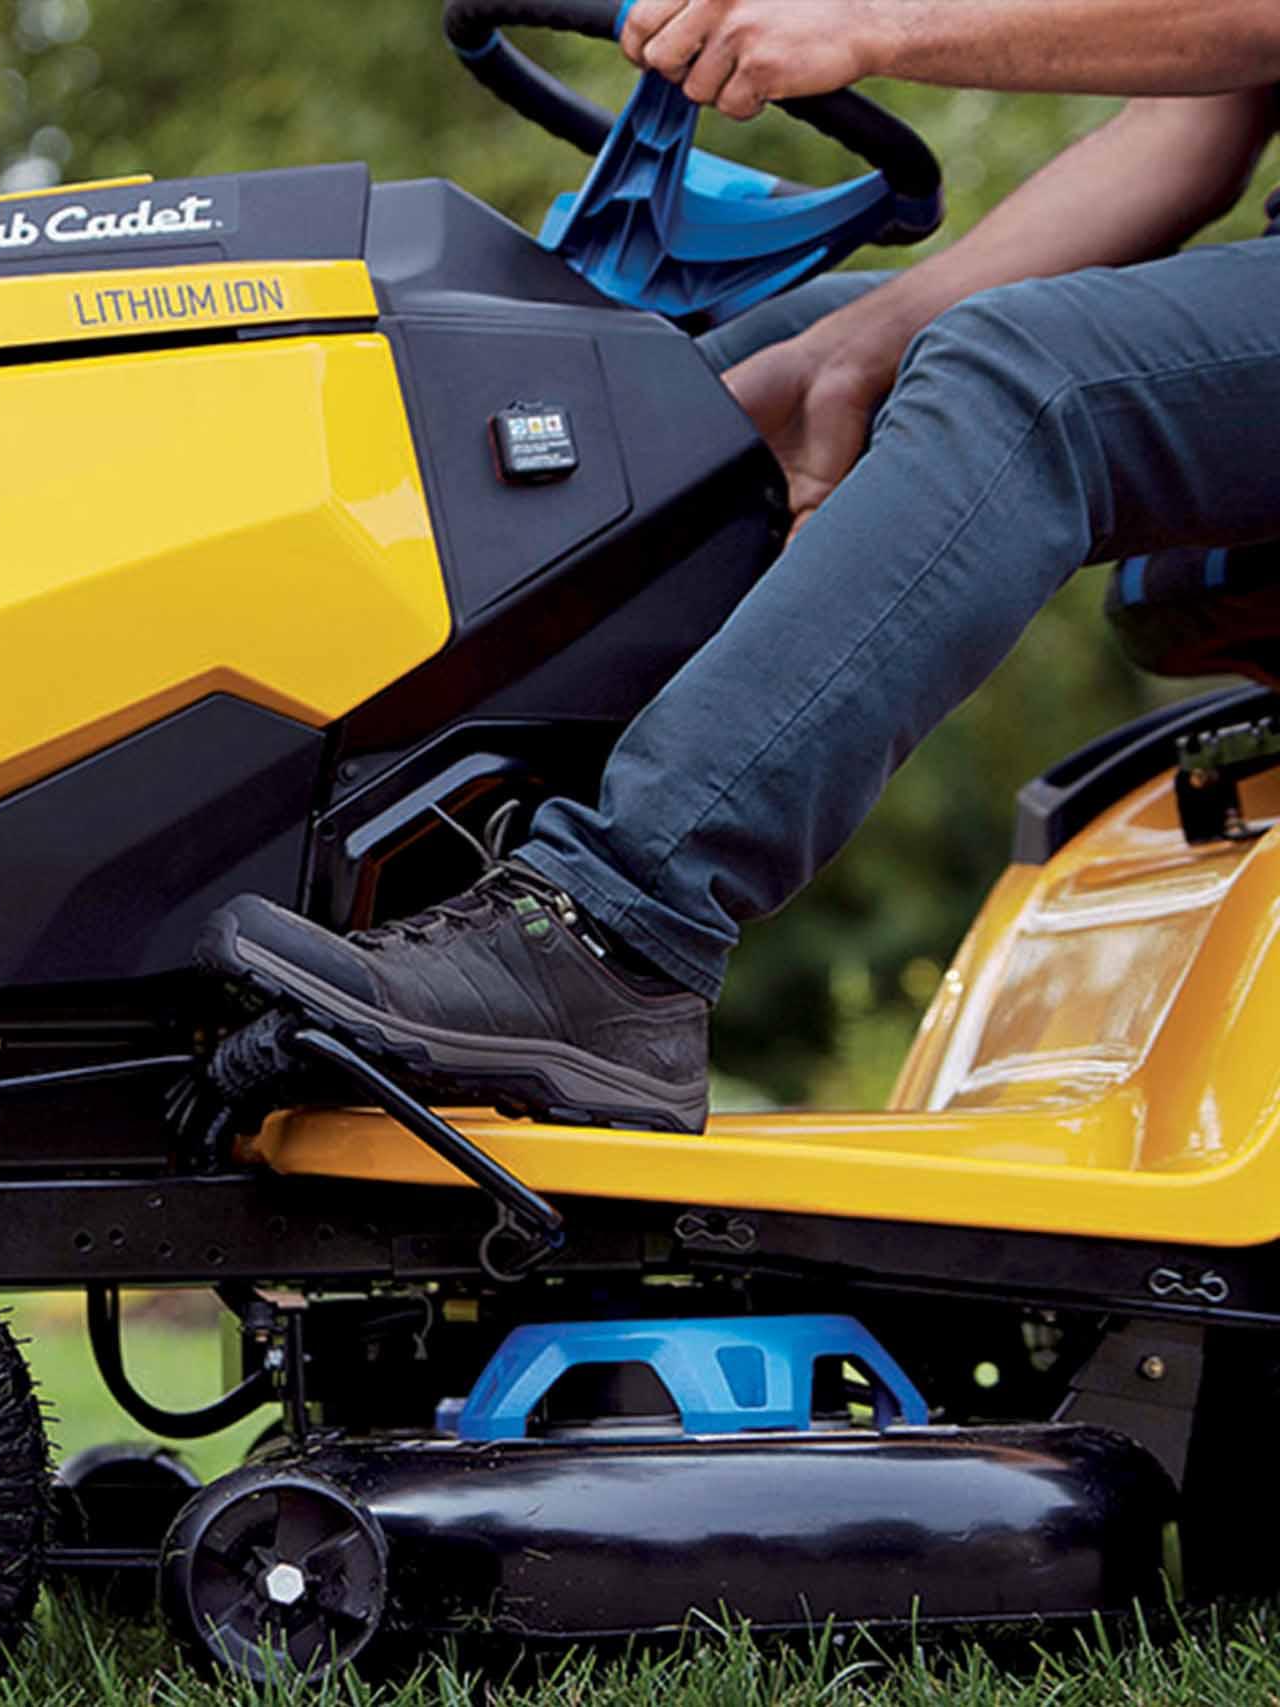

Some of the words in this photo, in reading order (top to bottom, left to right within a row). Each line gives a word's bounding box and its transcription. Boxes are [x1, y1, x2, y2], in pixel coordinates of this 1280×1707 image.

[44, 196, 214, 243] Cadet
[74, 284, 220, 326] LITHIUM
[226, 280, 285, 316] ION
